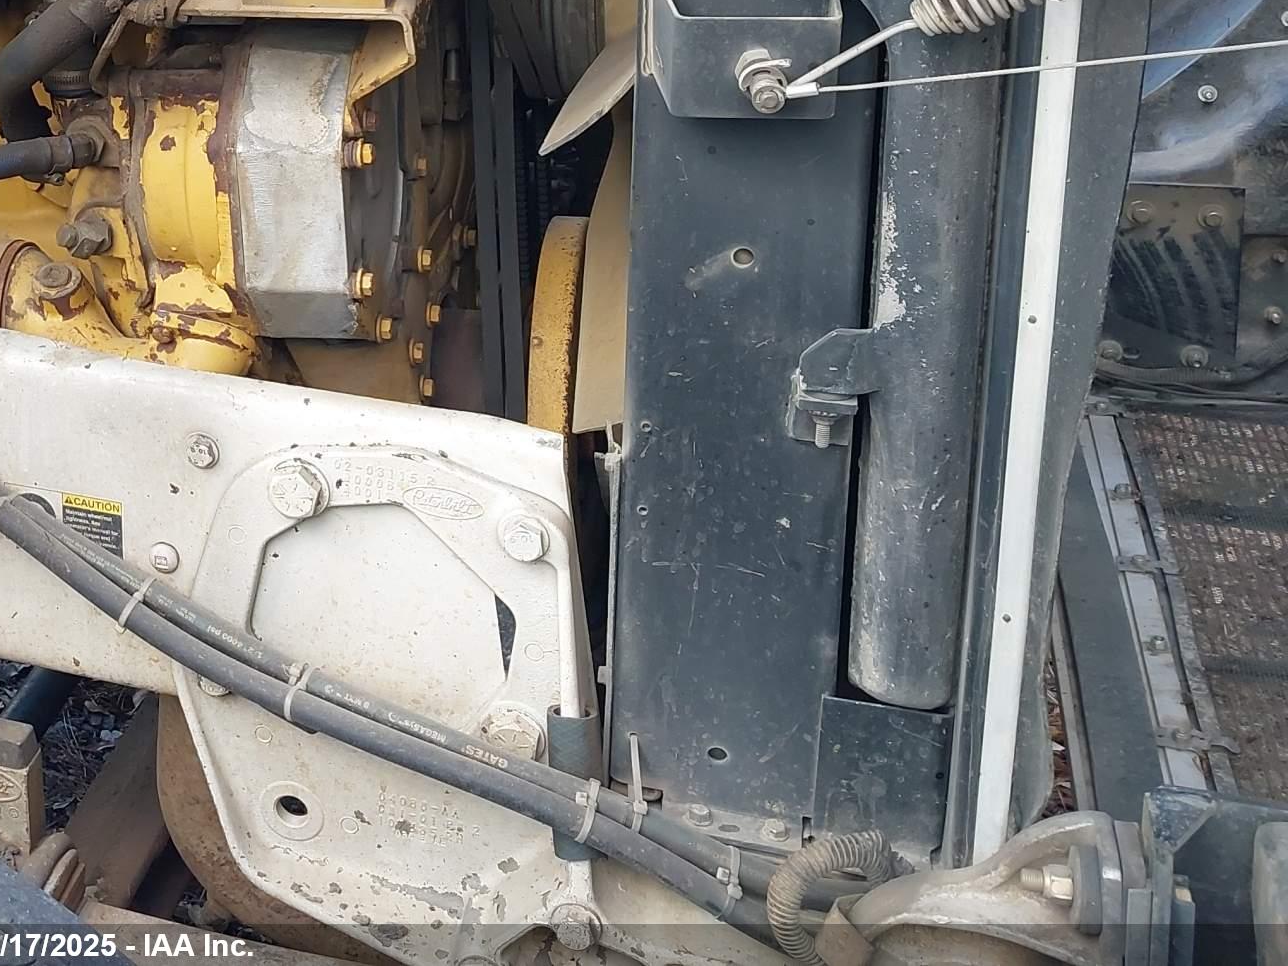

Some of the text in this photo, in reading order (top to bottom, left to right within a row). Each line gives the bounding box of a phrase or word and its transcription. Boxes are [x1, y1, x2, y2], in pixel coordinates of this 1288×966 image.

[73, 497, 120, 513] CAUTION
[411, 488, 481, 516] Peterbilt
[464, 743, 509, 769] GATES
